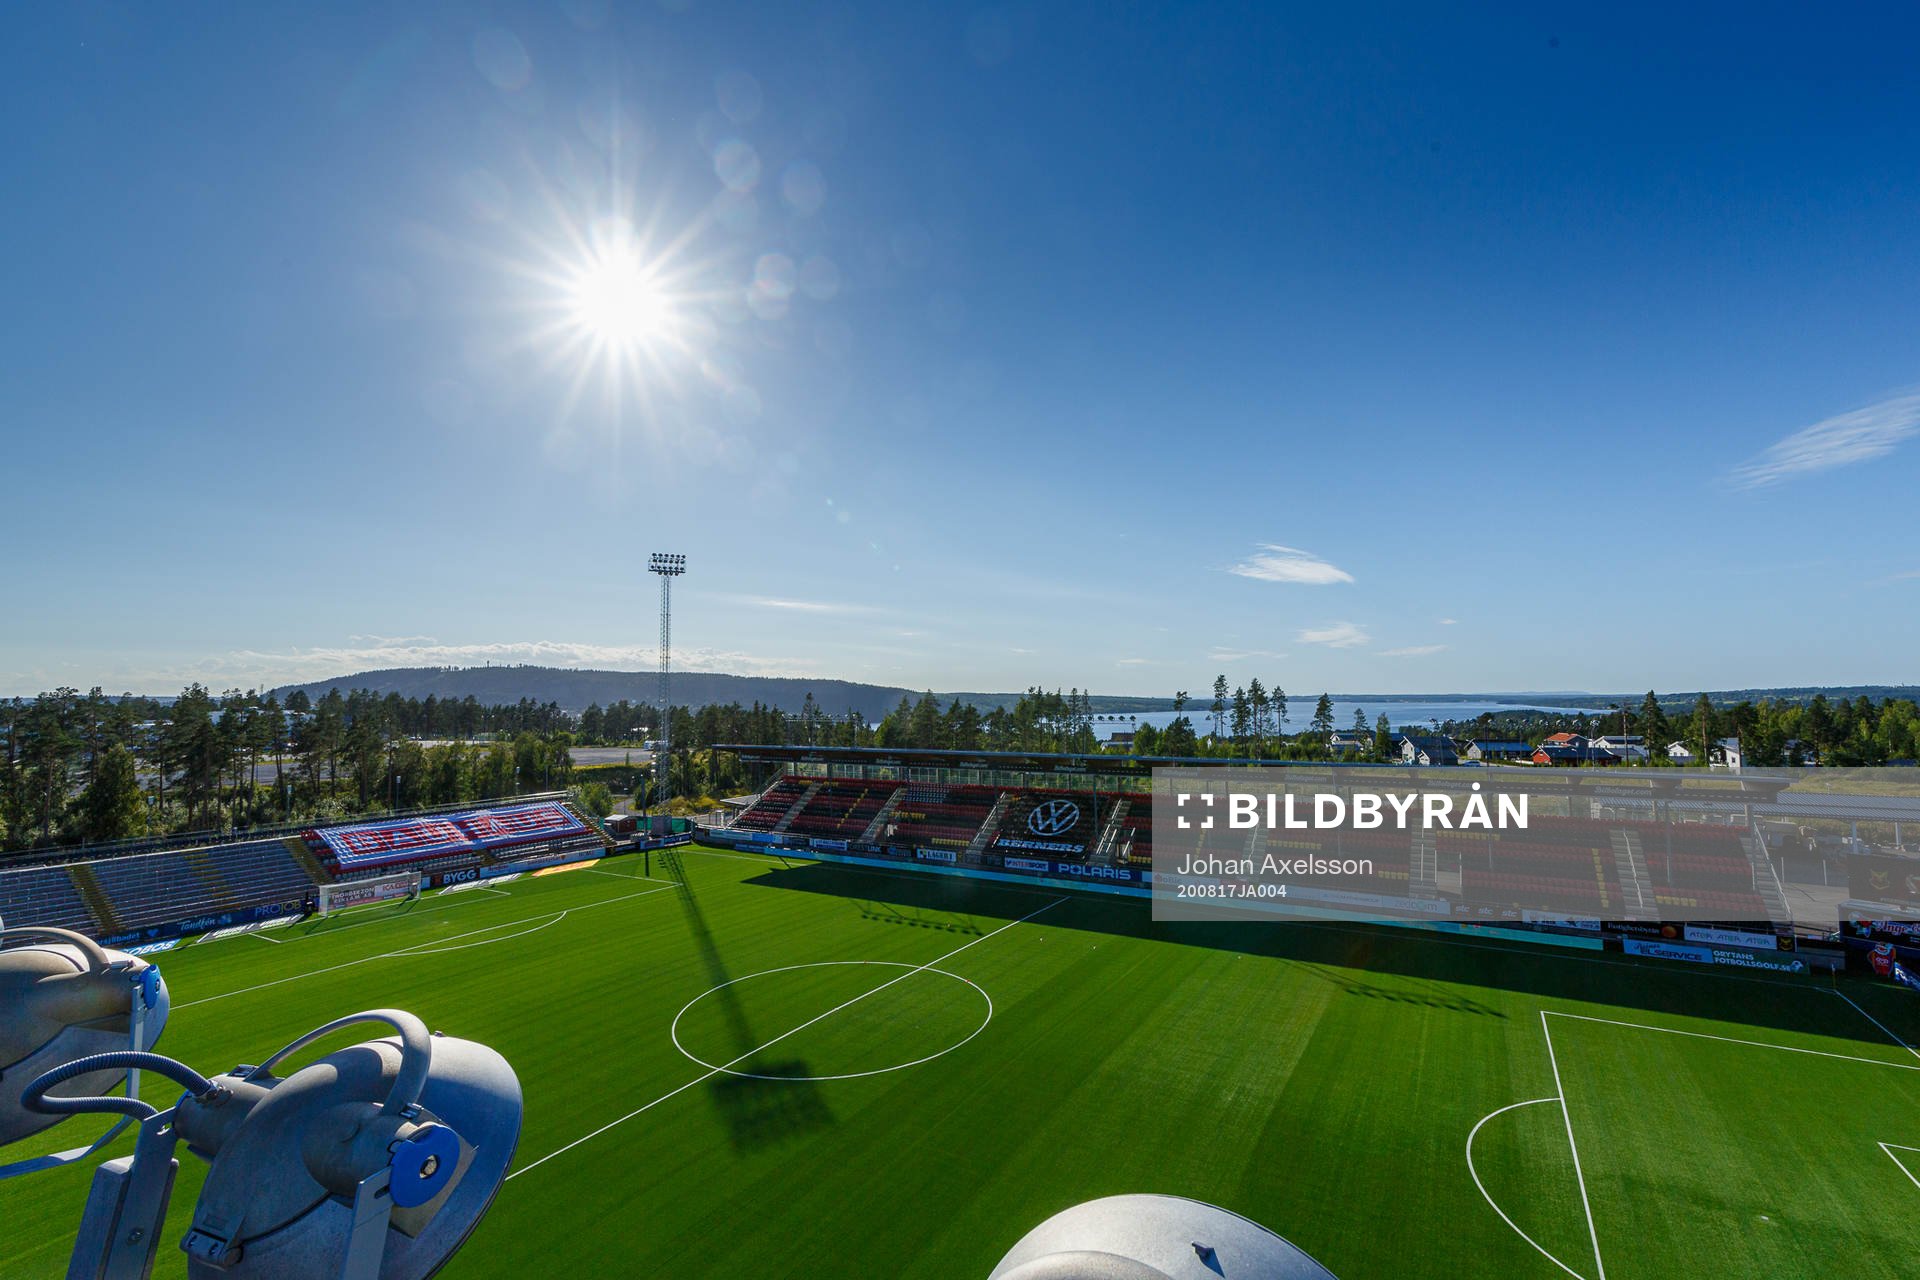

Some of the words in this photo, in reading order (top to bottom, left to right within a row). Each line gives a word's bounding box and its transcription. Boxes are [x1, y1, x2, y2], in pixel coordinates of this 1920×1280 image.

[998, 838, 1085, 853] BERNERS
[443, 869, 477, 884] BYGG
[1058, 863, 1132, 880] POLARIS
[255, 899, 302, 917] PROJOB
